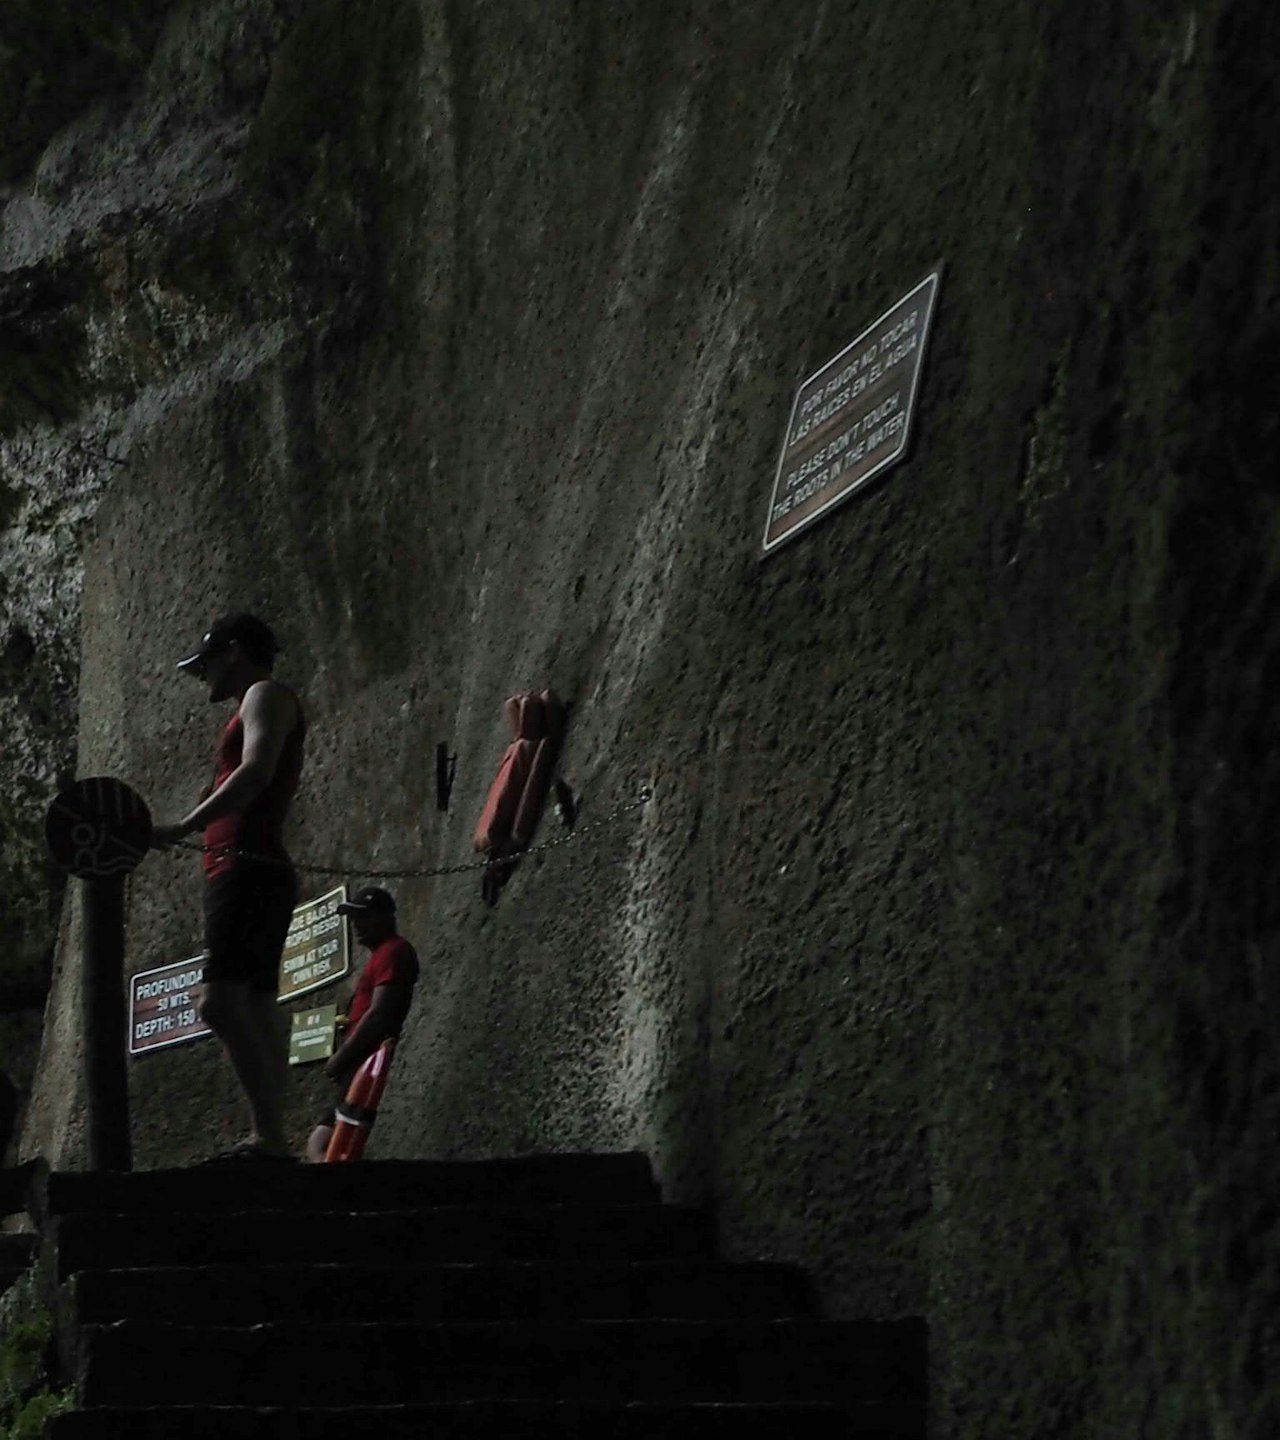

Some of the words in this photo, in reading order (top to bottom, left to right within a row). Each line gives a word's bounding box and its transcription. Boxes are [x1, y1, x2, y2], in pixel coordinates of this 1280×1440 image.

[789, 419, 812, 447] LAS
[812, 388, 851, 430] RAICES
[851, 373, 868, 399] EN
[885, 332, 919, 370] AGUA
[800, 389, 824, 417] POR
[824, 359, 860, 398] FAVOR
[860, 344, 878, 370] NO
[880, 309, 919, 354] TOCAR
[772, 494, 793, 523] THE
[793, 467, 829, 508] ROOTS
[829, 458, 844, 482] IN
[843, 440, 866, 471] THE
[867, 409, 906, 452] WATER
[786, 447, 827, 491] PLEASE
[826, 421, 862, 461] DON'T
[862, 390, 900, 434] TOUCH
[283, 953, 306, 974] SWIM
[305, 949, 317, 965] AT
[317, 938, 339, 958] YOUR
[292, 967, 312, 986] OWN
[311, 956, 332, 978] RISK
[135, 1015, 175, 1040] DEPTH:
[176, 1008, 196, 1028] 150
